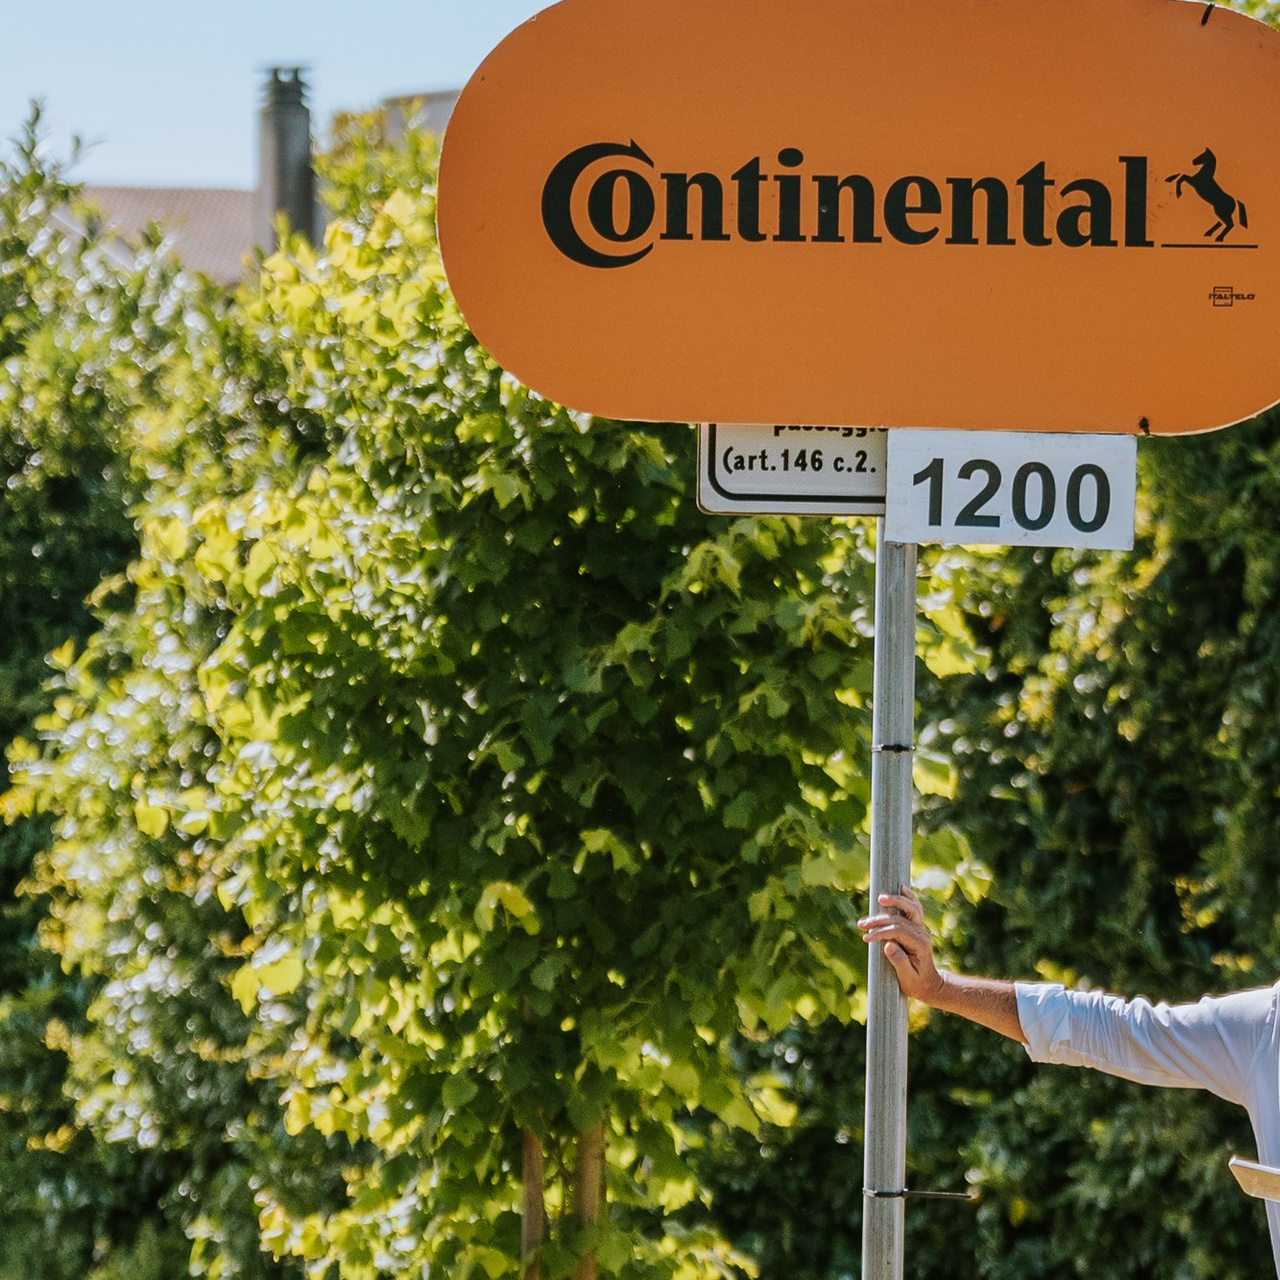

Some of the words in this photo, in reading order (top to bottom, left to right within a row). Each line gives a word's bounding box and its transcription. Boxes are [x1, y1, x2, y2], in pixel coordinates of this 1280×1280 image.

[541, 139, 1155, 269] Continental
[722, 445, 824, 475] (art.146
[833, 449, 877, 474] c.2.
[912, 457, 1112, 533] 1200
